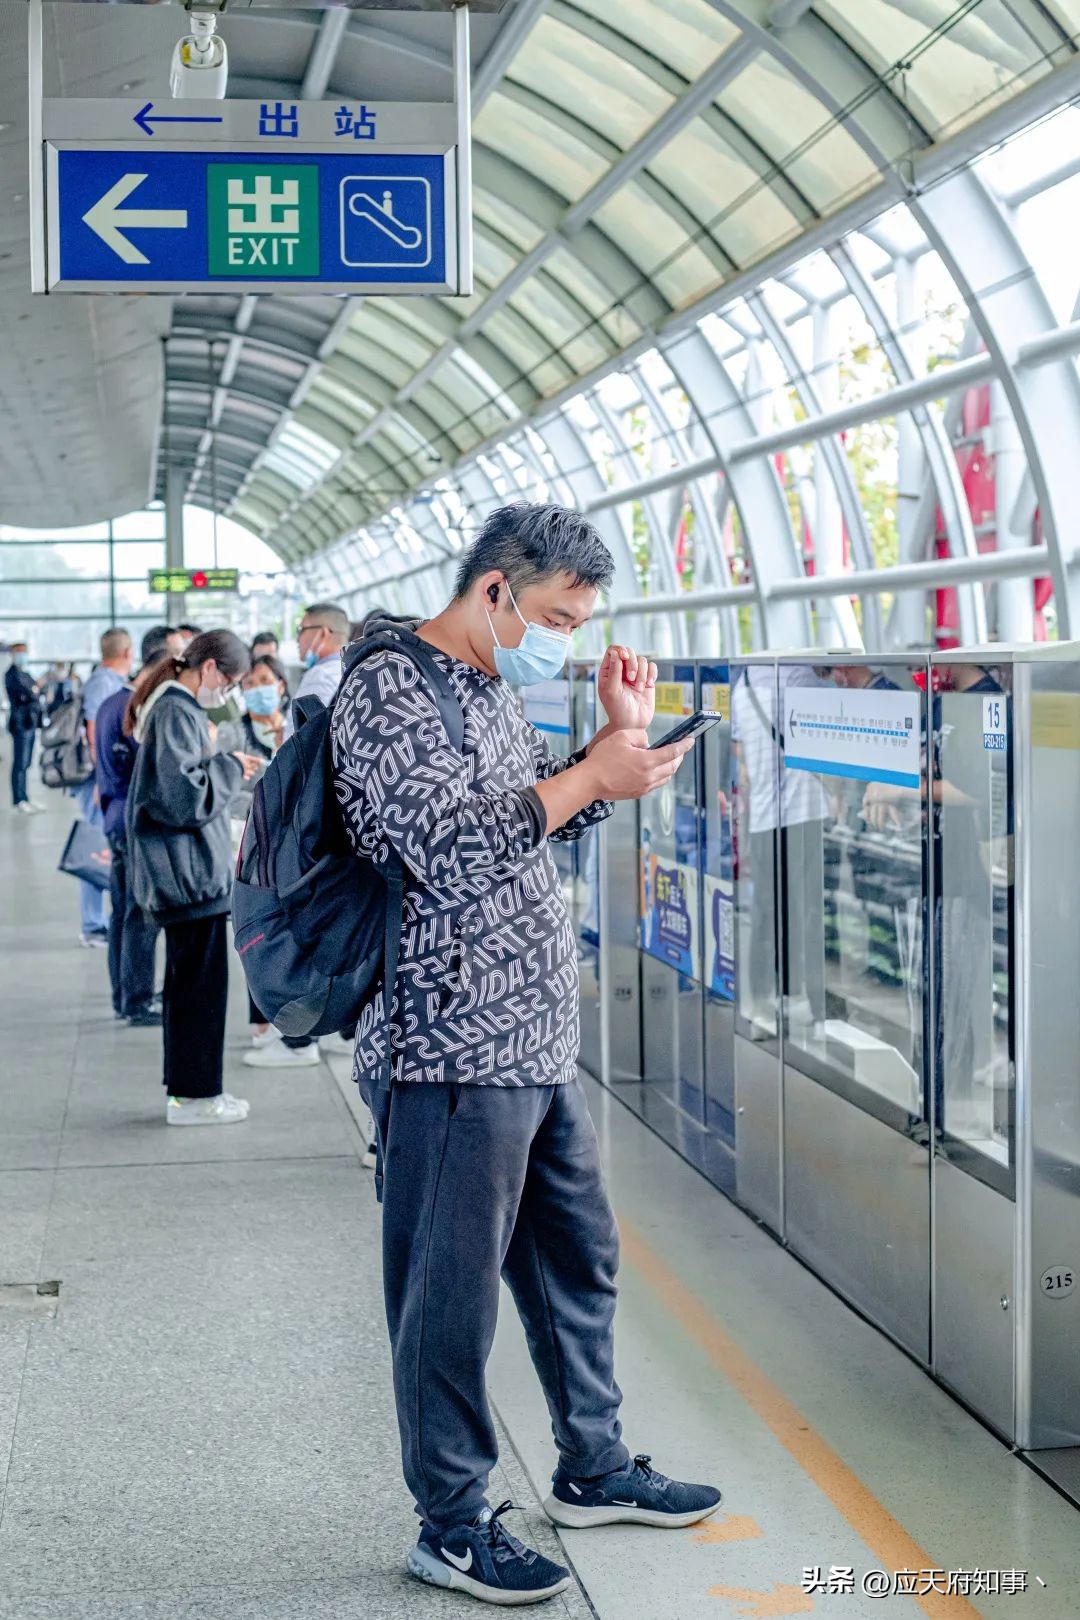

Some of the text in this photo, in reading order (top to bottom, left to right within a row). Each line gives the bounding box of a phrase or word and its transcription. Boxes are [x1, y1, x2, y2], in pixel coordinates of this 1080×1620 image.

[227, 238, 300, 266] EXIT
[988, 702, 1000, 729] 15
[984, 734, 1005, 749] PSD-215
[1044, 1273, 1073, 1290] 215
